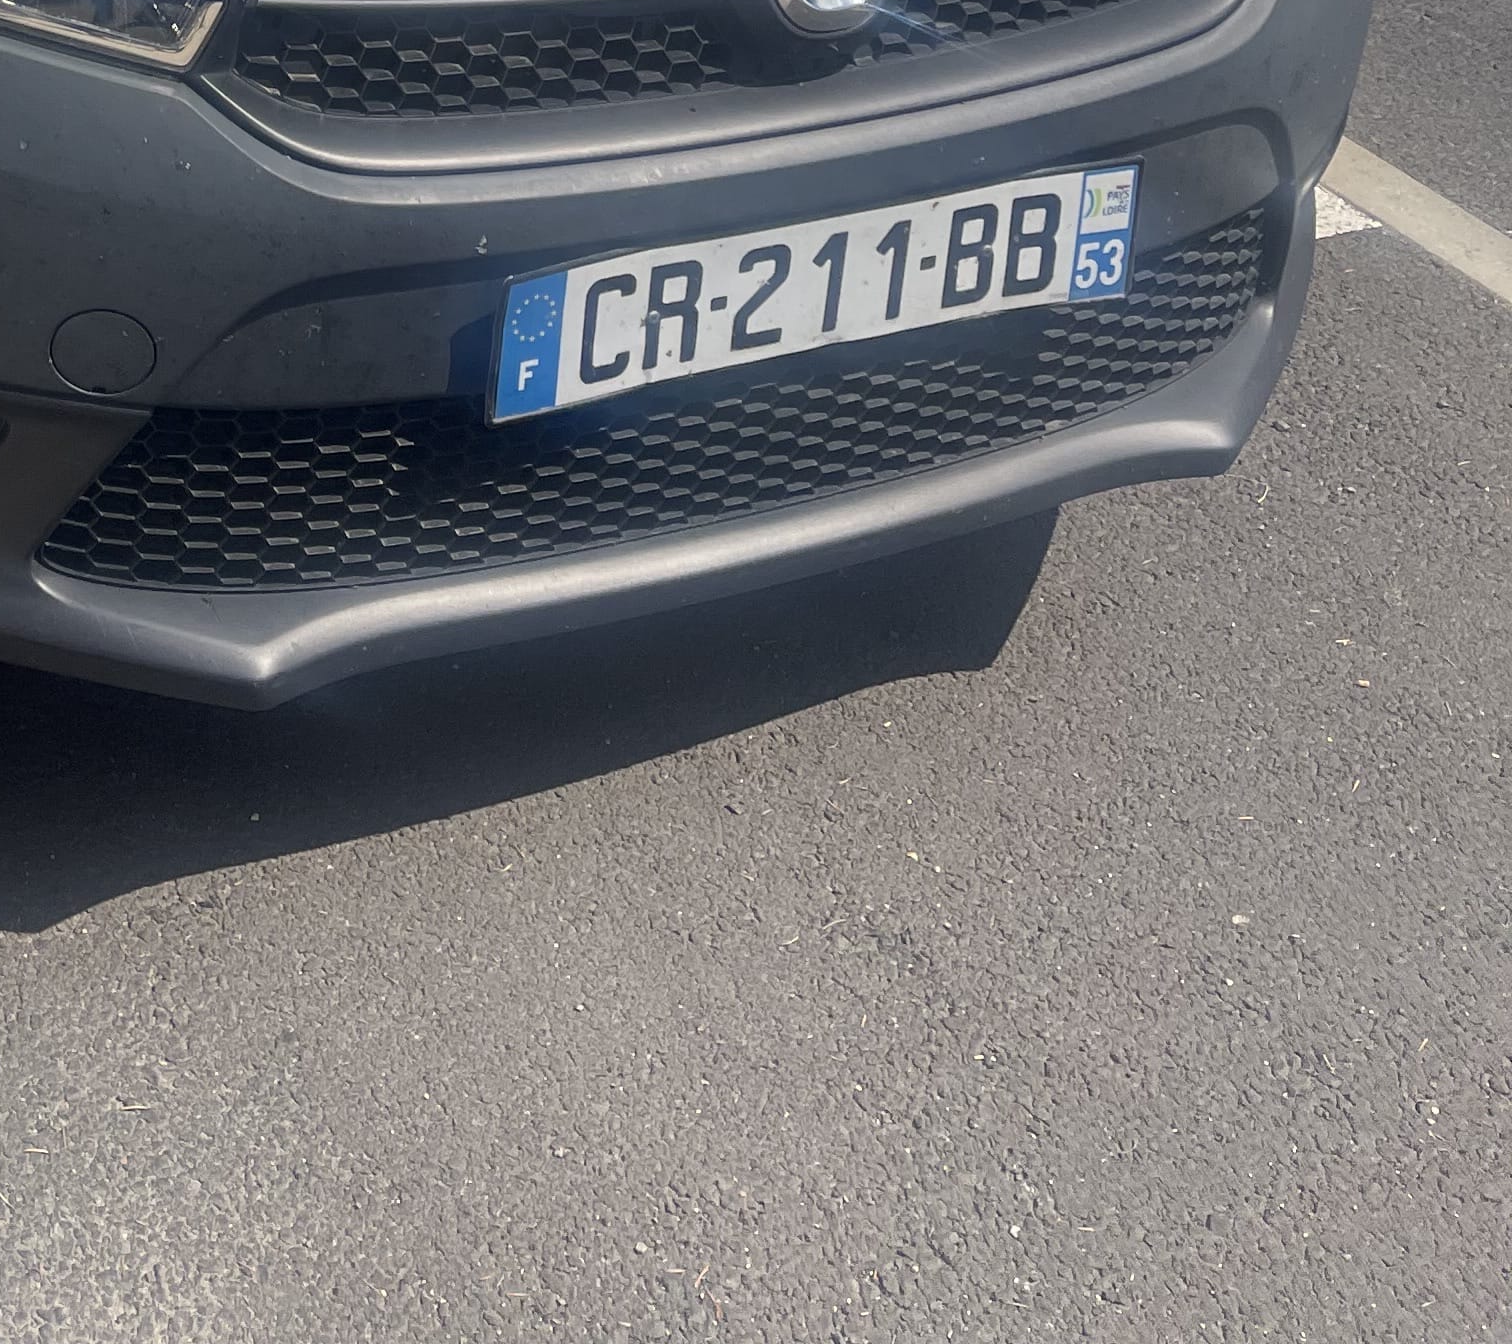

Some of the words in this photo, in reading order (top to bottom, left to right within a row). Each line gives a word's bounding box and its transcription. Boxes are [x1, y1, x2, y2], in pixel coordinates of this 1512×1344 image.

[1102, 204, 1129, 217] LOIRE
[1106, 190, 1130, 202] PAYS
[1075, 238, 1125, 289] 53
[579, 193, 1062, 385] CR-211-BB
[518, 358, 539, 392] F
